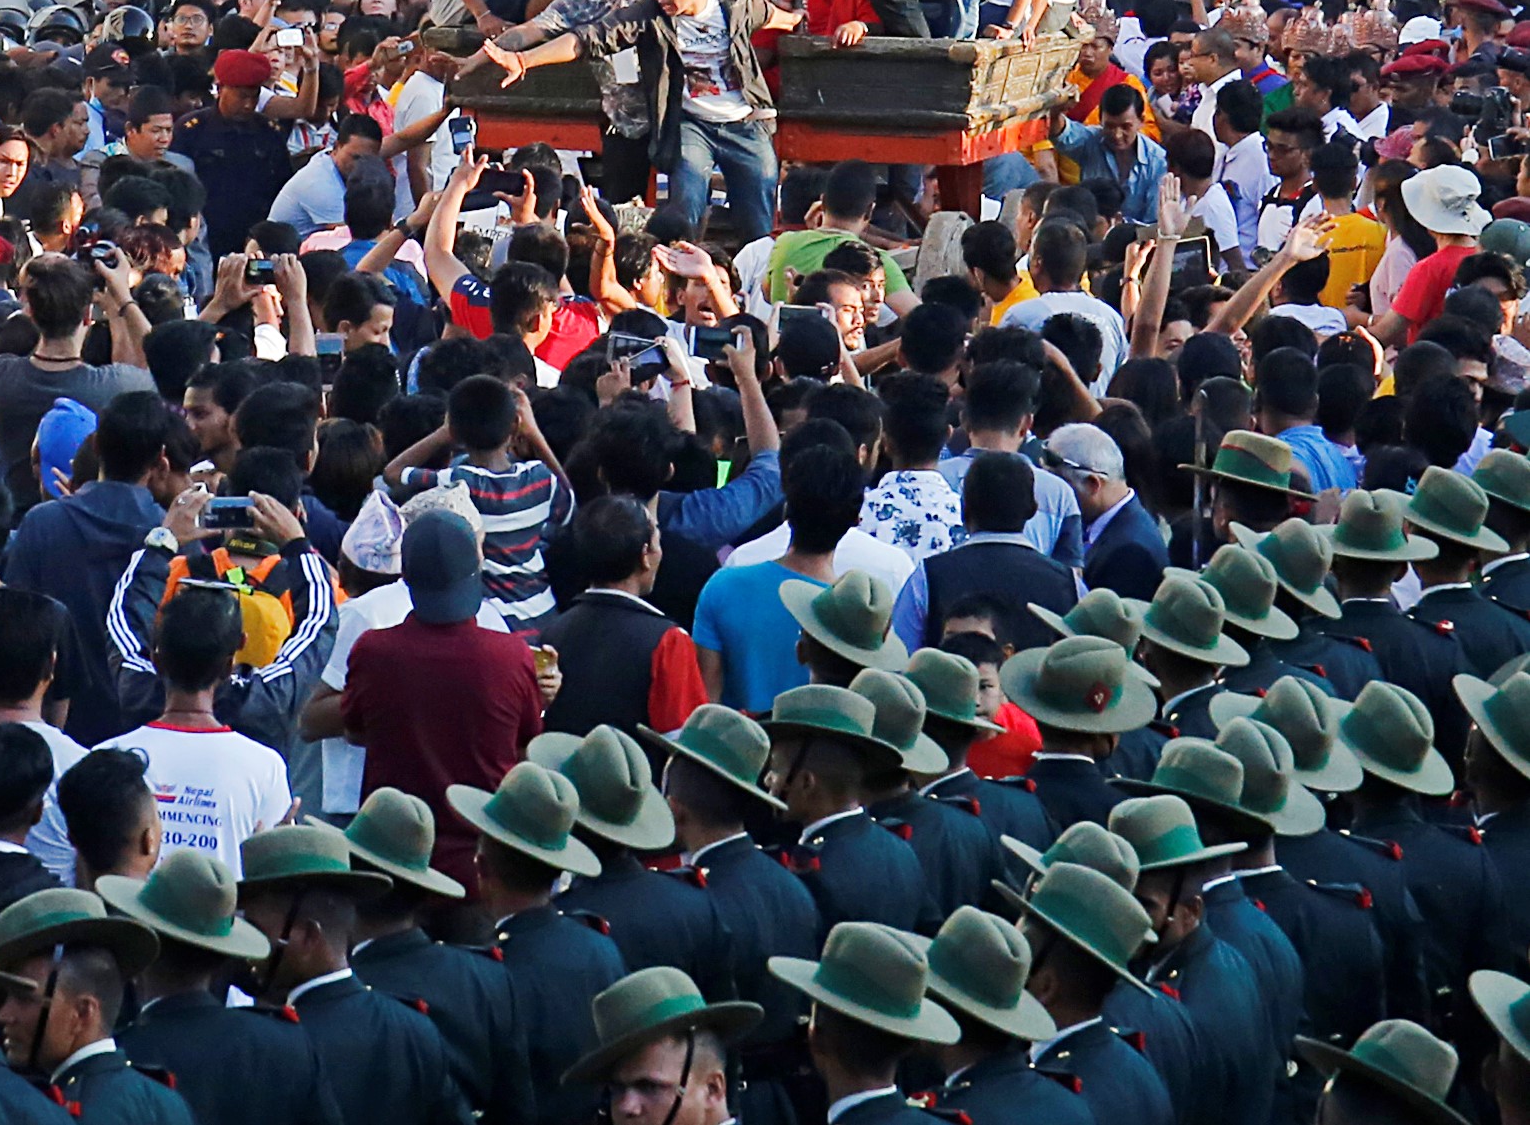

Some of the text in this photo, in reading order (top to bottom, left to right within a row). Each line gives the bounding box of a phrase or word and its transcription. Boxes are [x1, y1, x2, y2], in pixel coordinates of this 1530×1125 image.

[184, 785, 215, 798] Nepal
[177, 795, 217, 808] Airlines
[158, 810, 222, 827] MMENCING
[160, 830, 218, 850] 30-200
